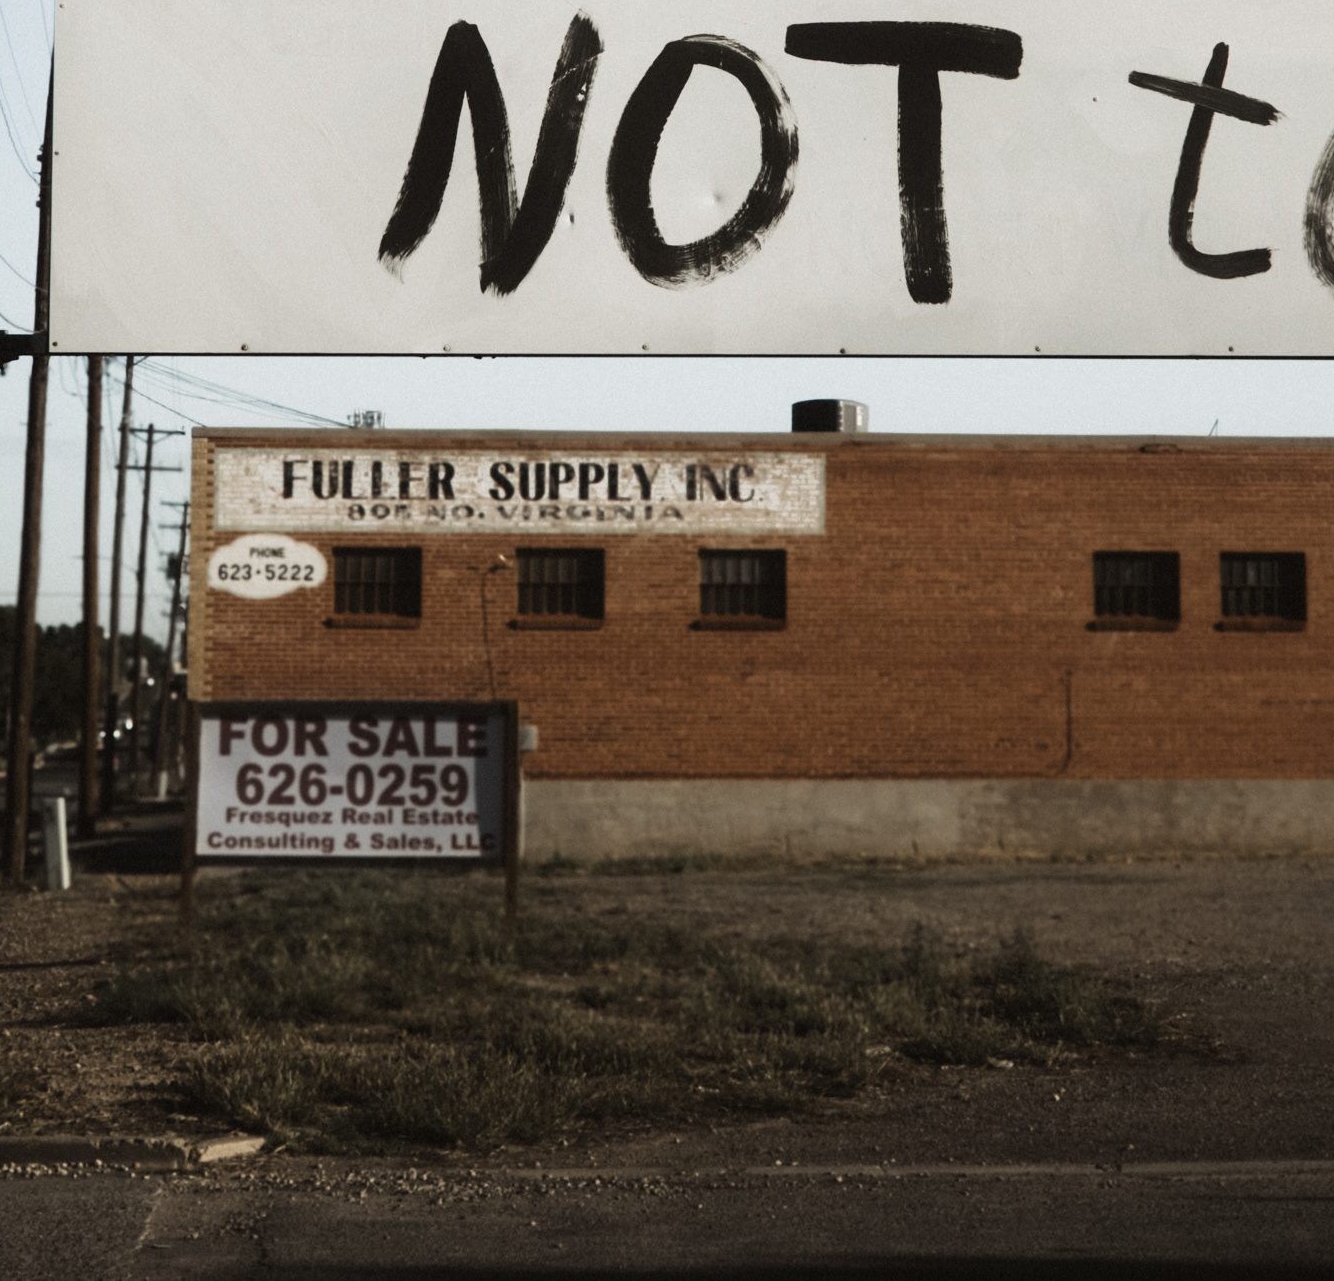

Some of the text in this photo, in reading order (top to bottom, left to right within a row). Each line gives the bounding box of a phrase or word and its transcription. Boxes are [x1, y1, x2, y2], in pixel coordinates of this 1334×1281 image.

[377, 10, 1025, 308] NOT
[281, 459, 456, 501] FULLER
[496, 504, 685, 521] VIRGINIA
[249, 547, 286, 558] PHONE
[218, 717, 488, 758] FOR SALE
[235, 762, 469, 807] 626-0259
[225, 807, 479, 828] Fresquez Real Estate
[207, 831, 495, 854] Consulting & Sales, LLC
